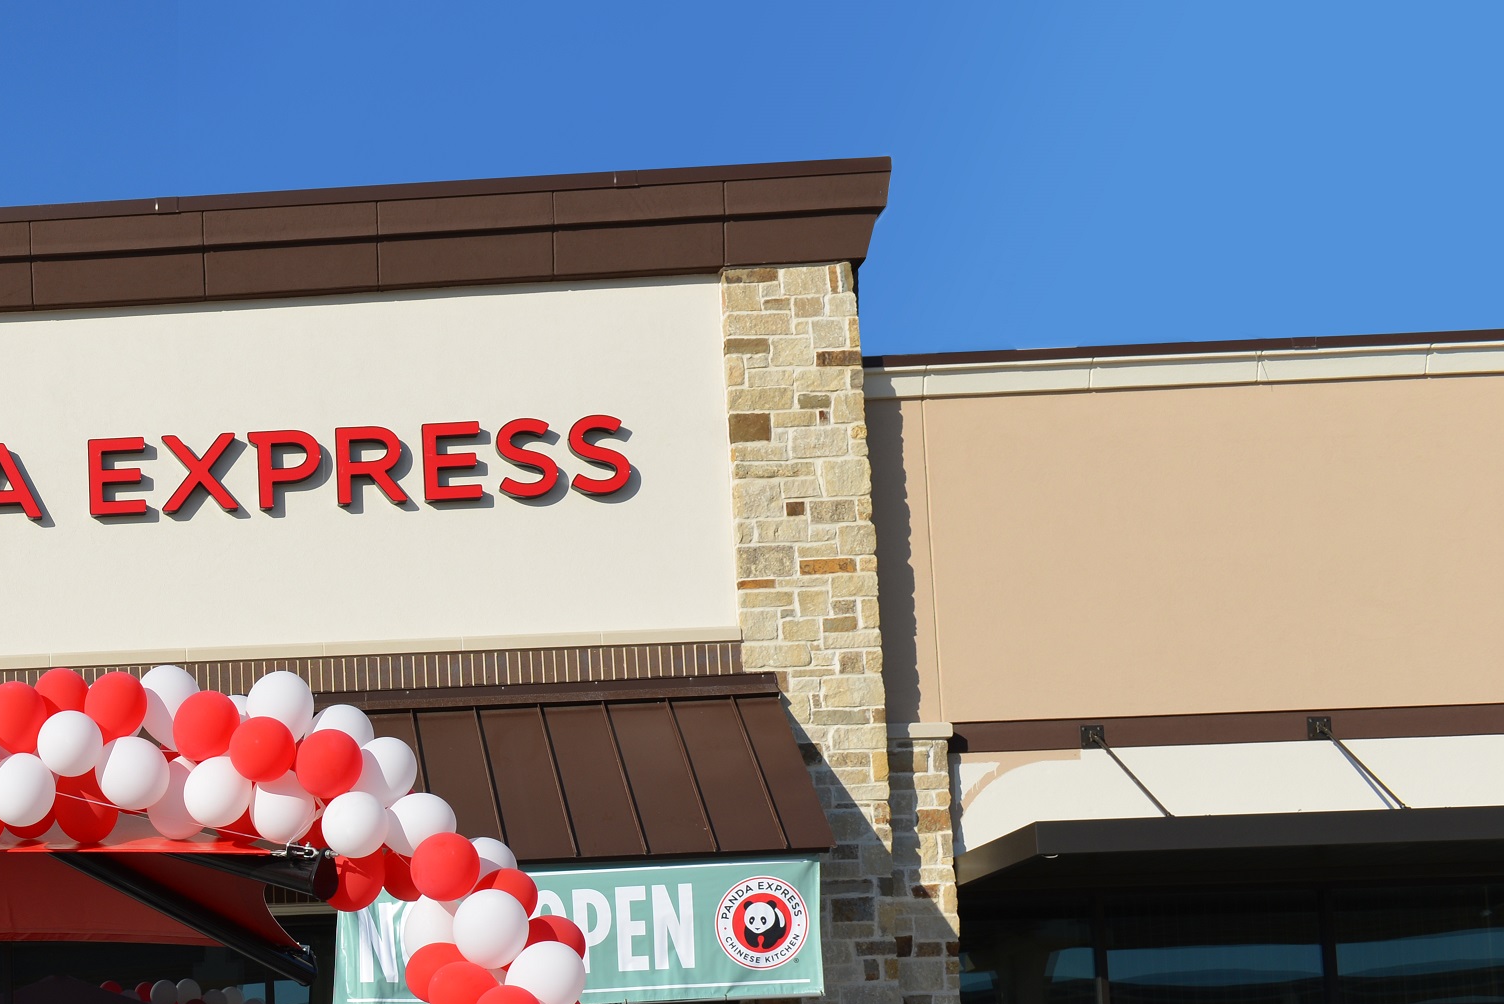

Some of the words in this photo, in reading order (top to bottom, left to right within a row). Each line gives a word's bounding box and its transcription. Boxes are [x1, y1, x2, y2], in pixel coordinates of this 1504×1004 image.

[88, 415, 632, 517] EXPRESS
[537, 883, 696, 973] PEN
[721, 884, 754, 920] PANDA
[757, 881, 803, 917] EXPRESS
[725, 936, 761, 964] CHINESE
[764, 933, 800, 964] KITCHEN
